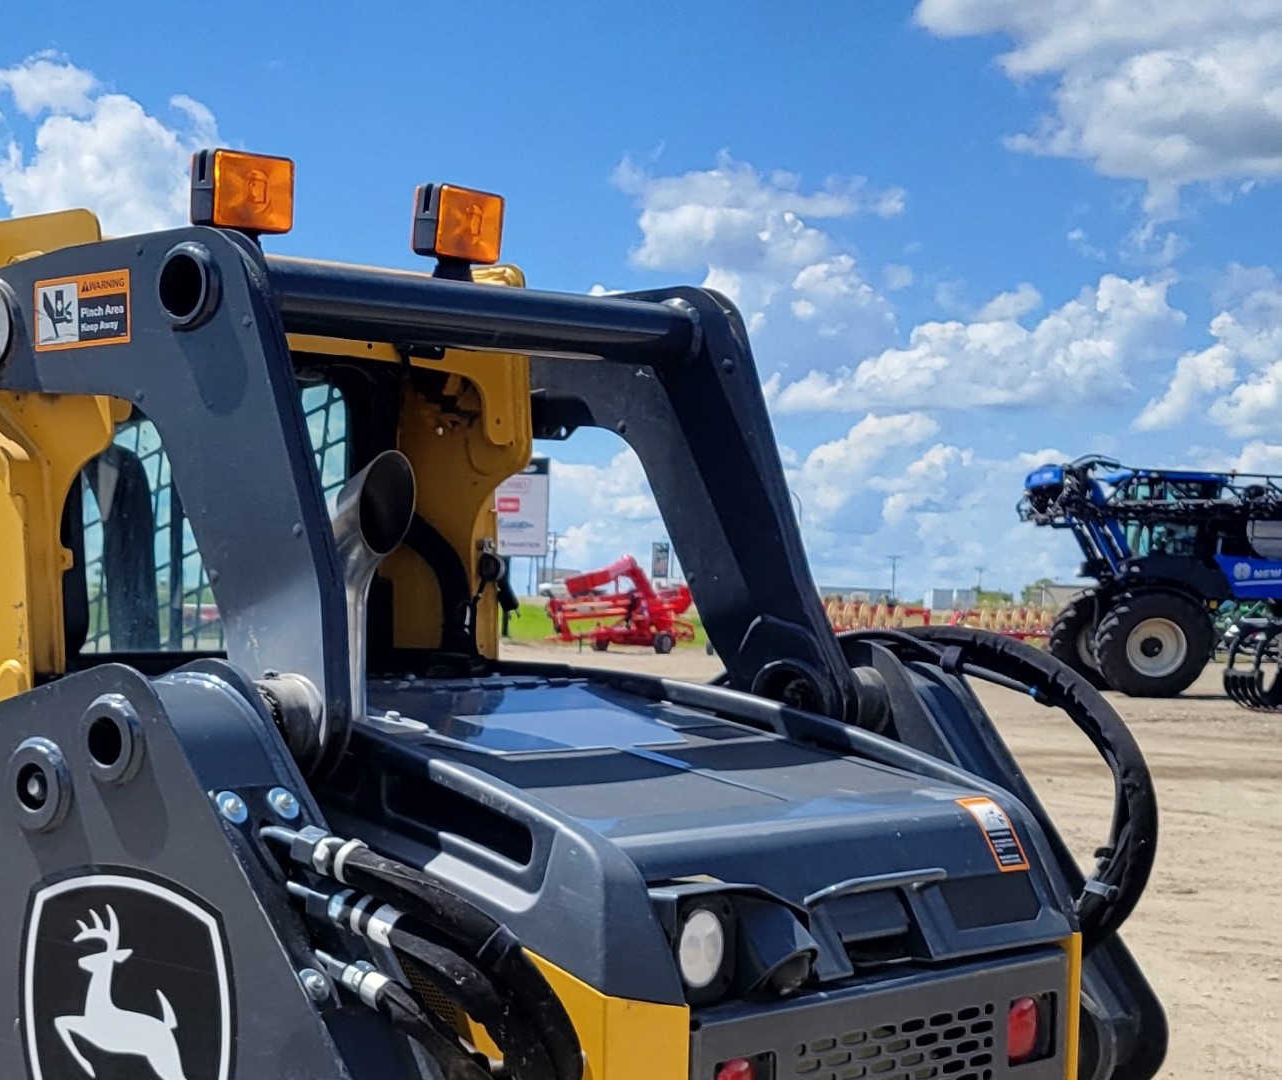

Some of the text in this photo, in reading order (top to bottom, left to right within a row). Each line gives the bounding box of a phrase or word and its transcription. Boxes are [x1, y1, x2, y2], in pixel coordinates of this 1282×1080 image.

[89, 278, 125, 292] WARNING
[80, 304, 124, 318] Pinch Area
[80, 320, 119, 333] Keep Away
